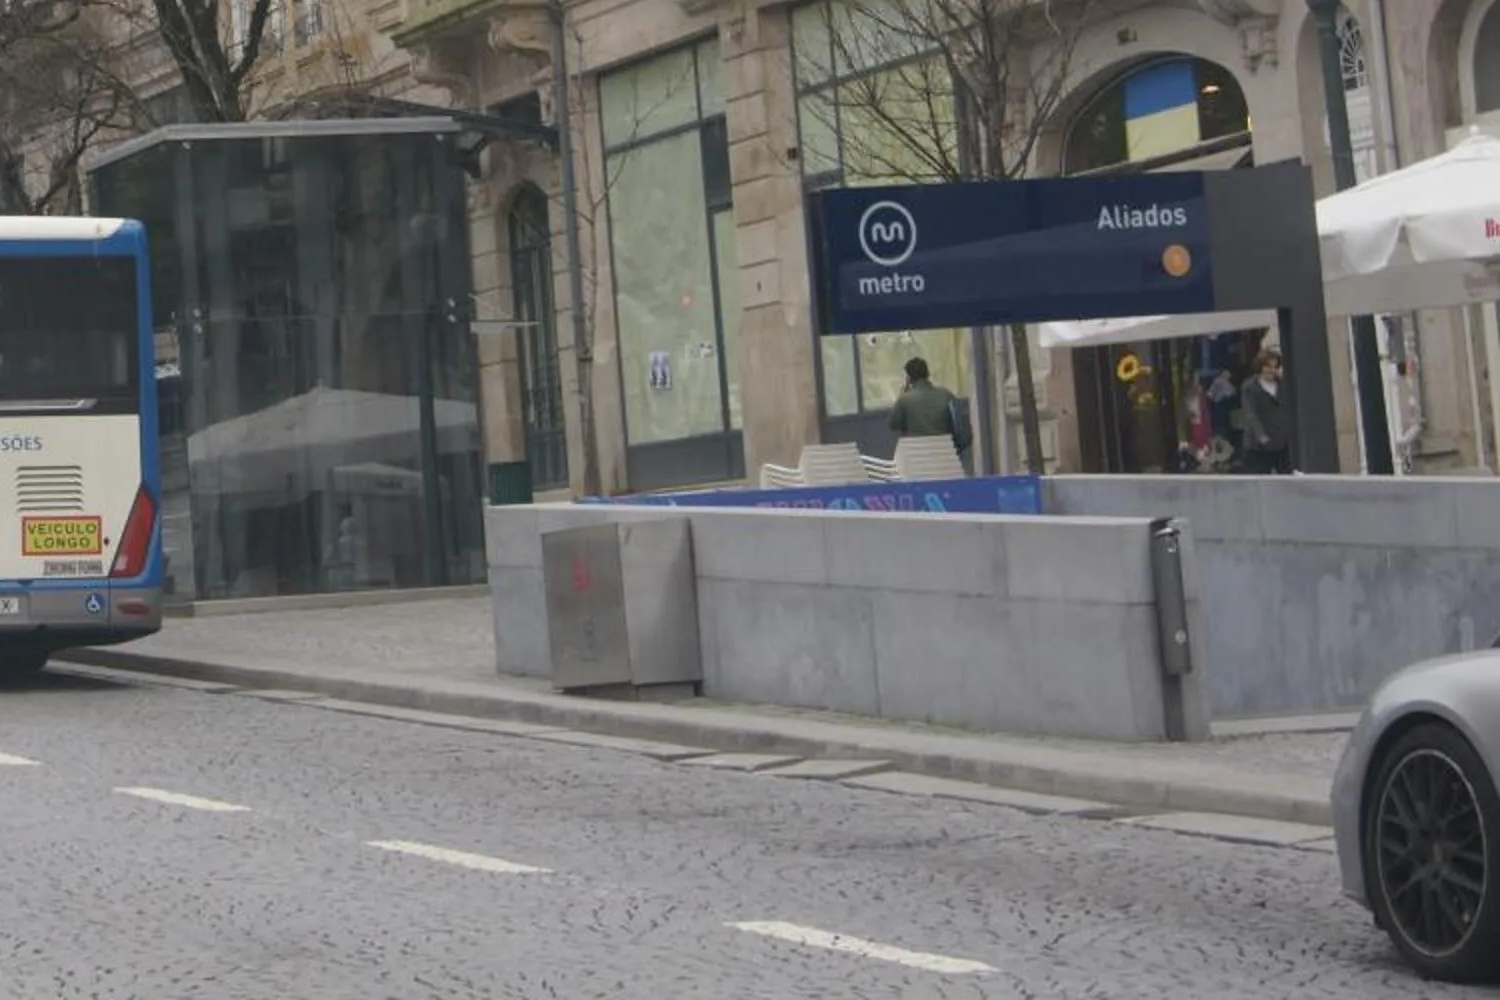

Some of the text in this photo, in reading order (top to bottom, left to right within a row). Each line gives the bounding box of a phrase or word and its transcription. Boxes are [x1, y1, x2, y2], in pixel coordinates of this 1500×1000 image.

[1097, 203, 1188, 230] Aliados
[859, 272, 925, 295] metro
[33, 536, 92, 550] LONGO
